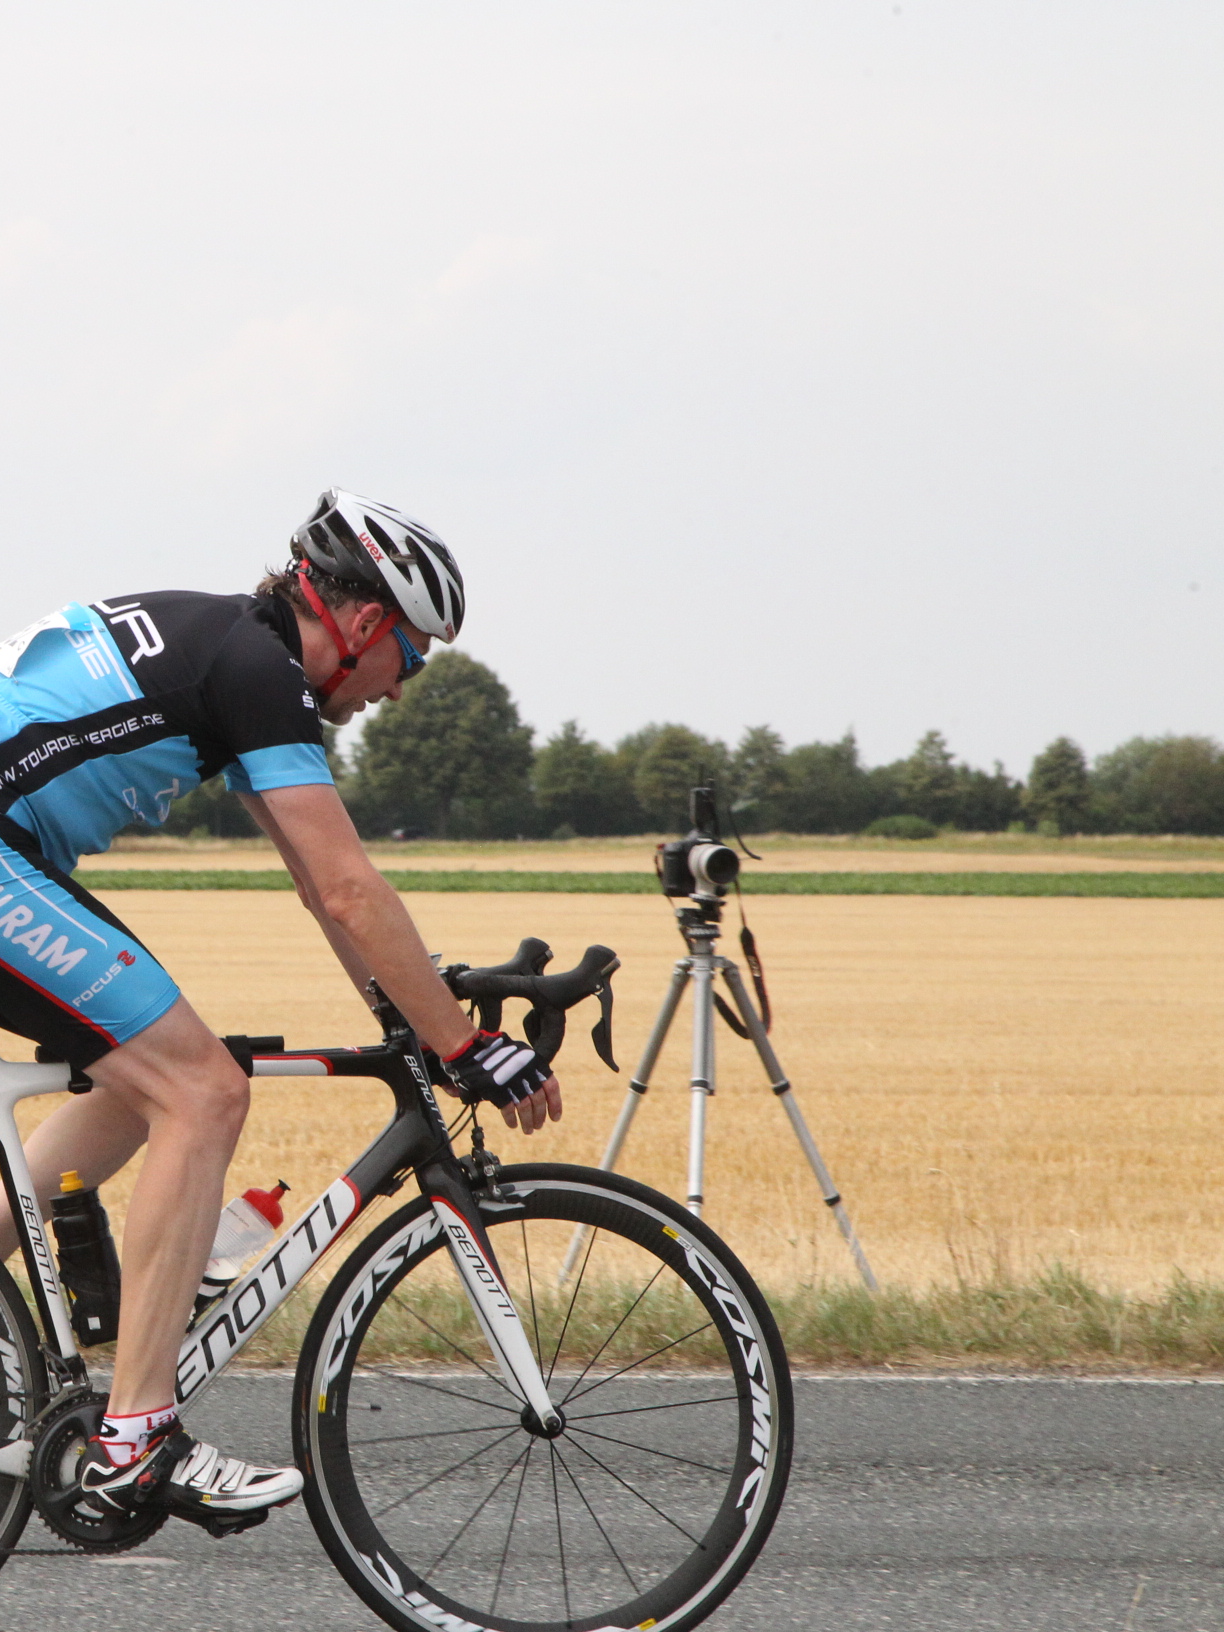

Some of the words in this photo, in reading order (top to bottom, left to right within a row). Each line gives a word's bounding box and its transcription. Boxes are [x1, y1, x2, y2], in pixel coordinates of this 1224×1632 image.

[358, 532, 384, 563] uvex
[72, 963, 122, 1007] FOCUS
[19, 1194, 58, 1295] BENOTTI
[448, 1224, 517, 1318] BENOTTI
